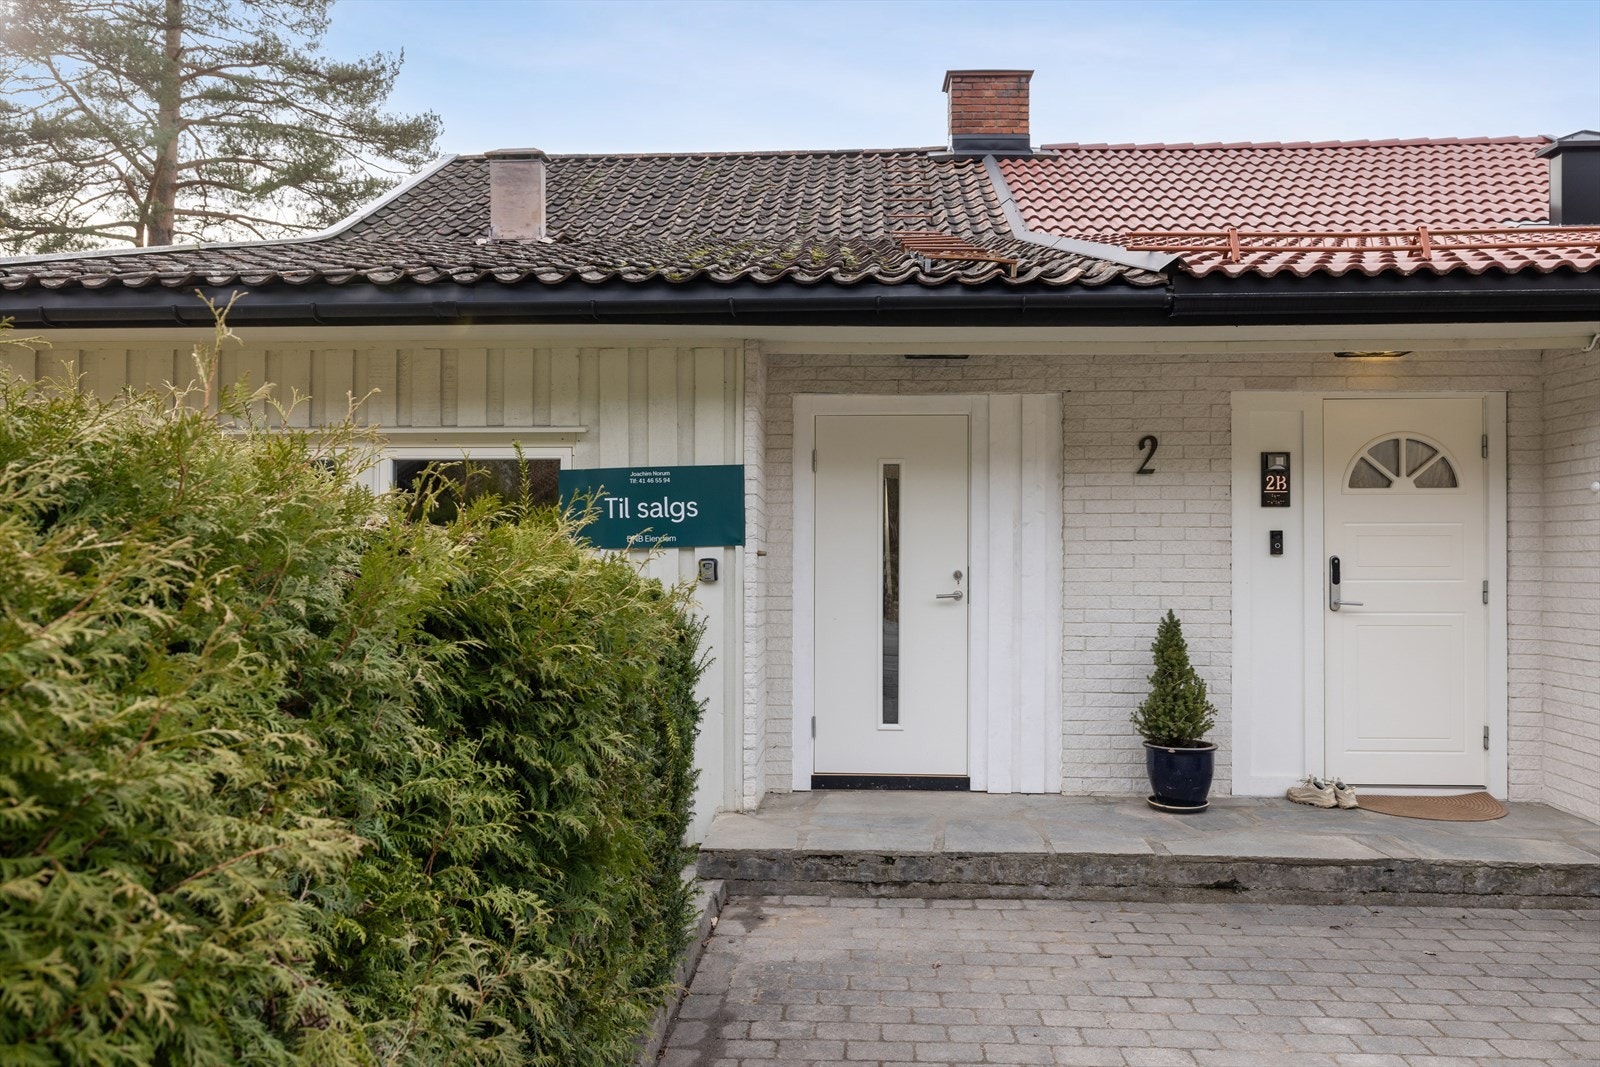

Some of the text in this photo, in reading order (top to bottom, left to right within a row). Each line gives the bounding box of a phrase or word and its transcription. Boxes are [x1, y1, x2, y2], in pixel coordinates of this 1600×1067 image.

[1136, 435, 1158, 474] 2
[1265, 475, 1287, 490] 2B
[604, 496, 698, 523] Til salgs
